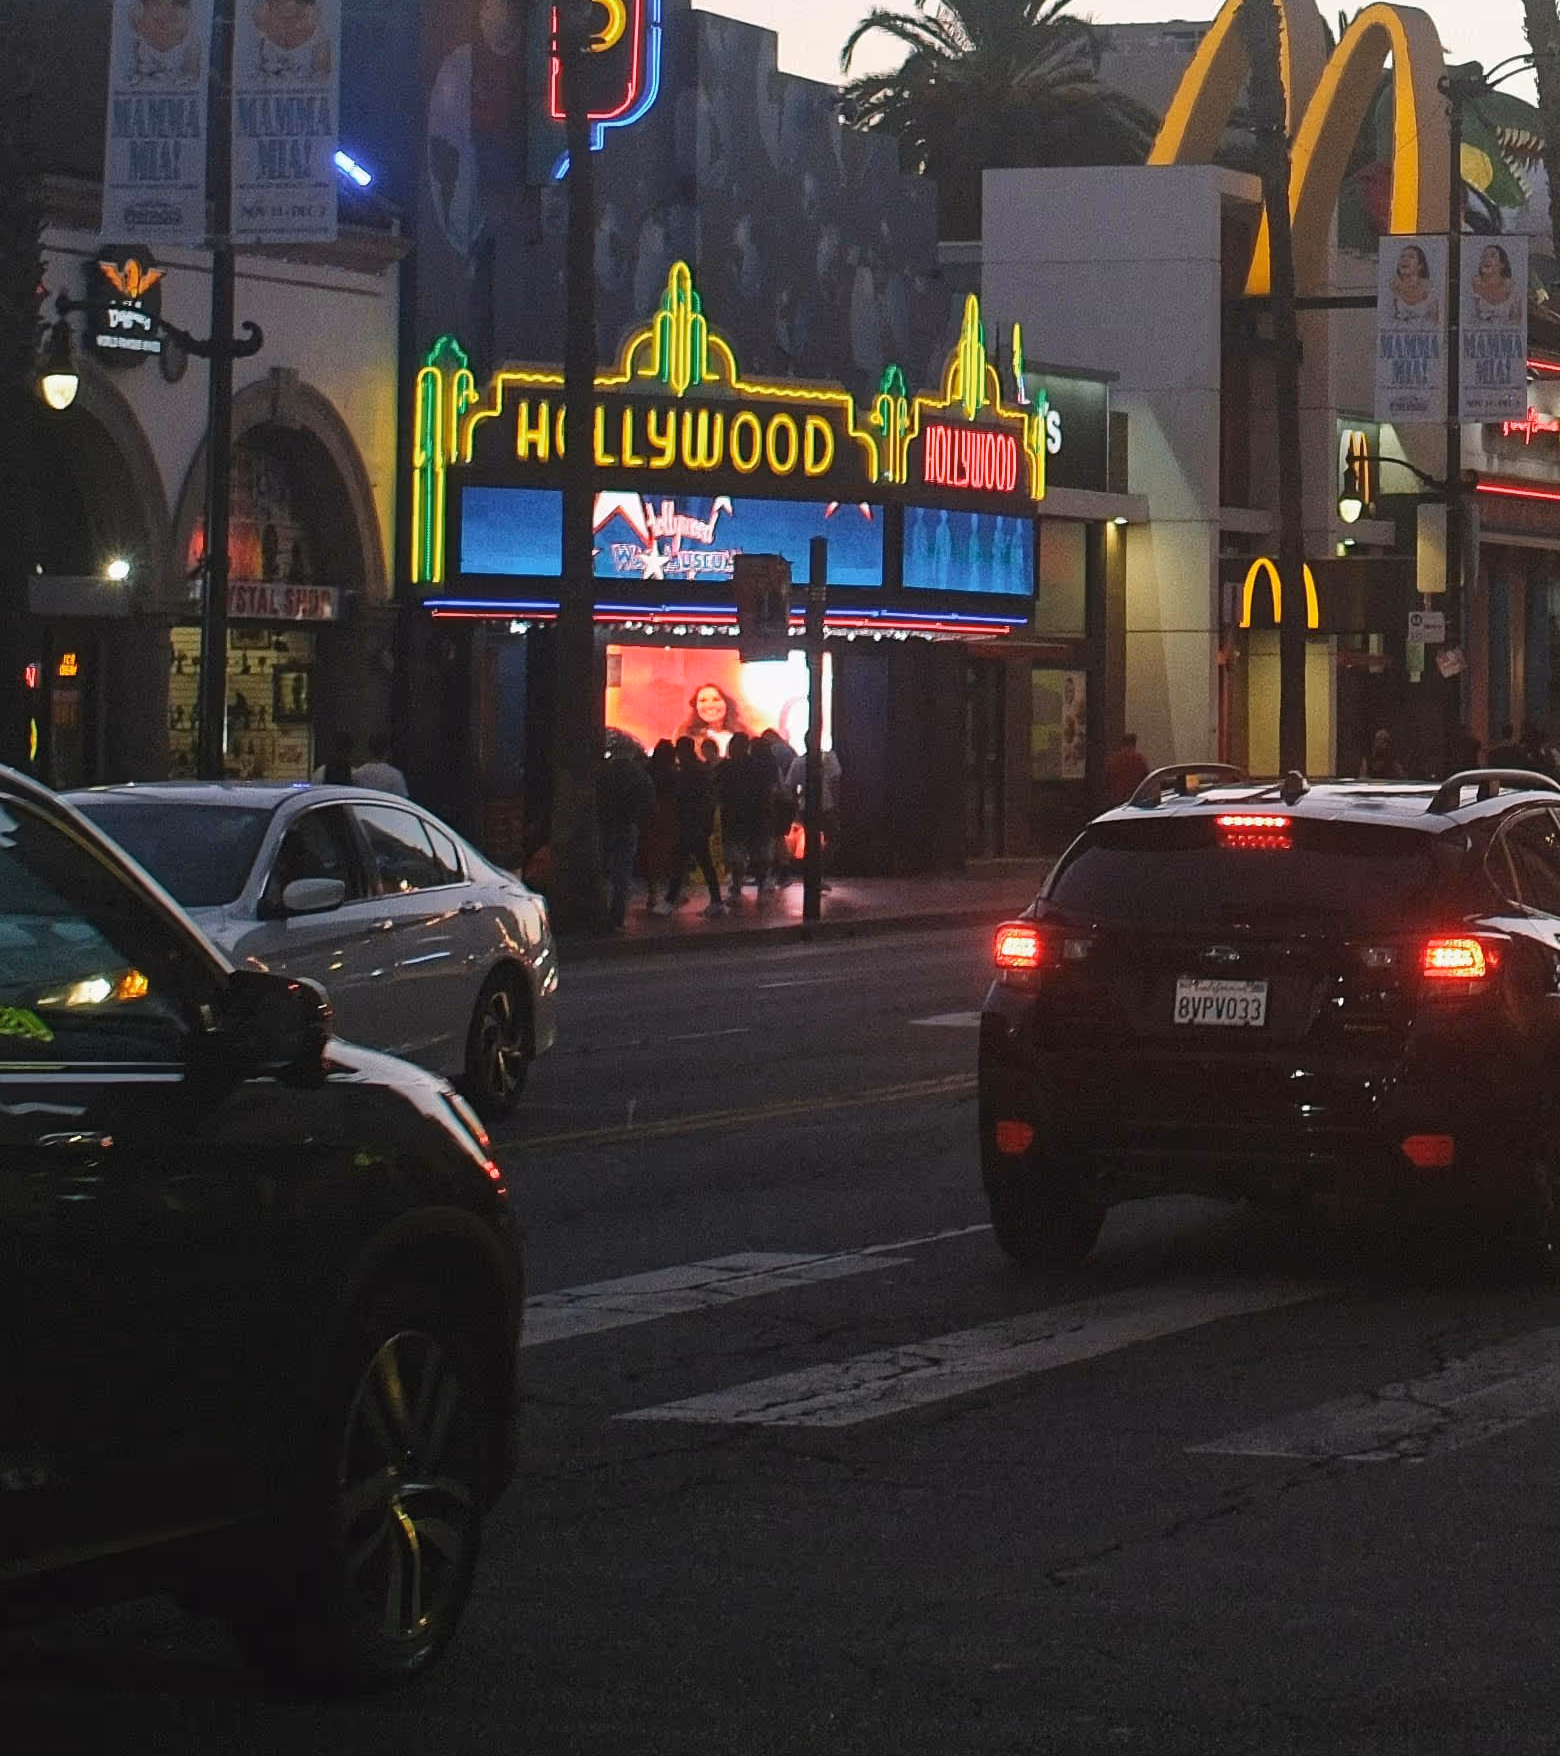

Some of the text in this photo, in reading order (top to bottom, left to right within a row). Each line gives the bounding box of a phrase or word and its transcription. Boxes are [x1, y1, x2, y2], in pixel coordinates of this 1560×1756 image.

[516, 400, 836, 477] HLLYWOOD
[925, 425, 1018, 493] HOLLYWOOD
[1178, 996, 1262, 1021] 8VPV033
